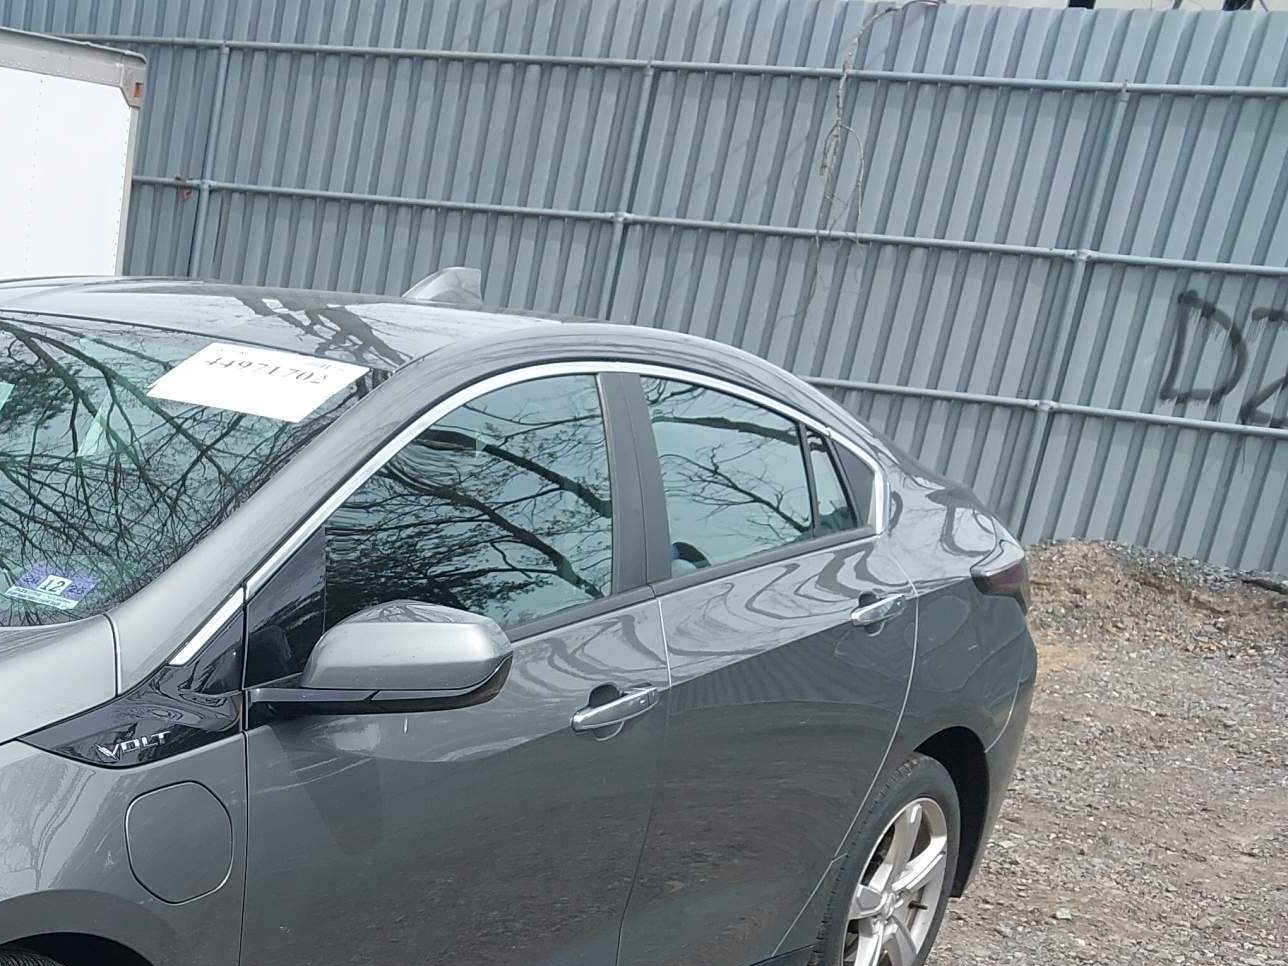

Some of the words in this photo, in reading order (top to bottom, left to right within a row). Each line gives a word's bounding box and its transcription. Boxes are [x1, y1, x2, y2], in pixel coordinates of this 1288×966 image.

[204, 356, 331, 385] 44971702
[40, 579, 65, 593] 12
[95, 731, 170, 759] VOLT
